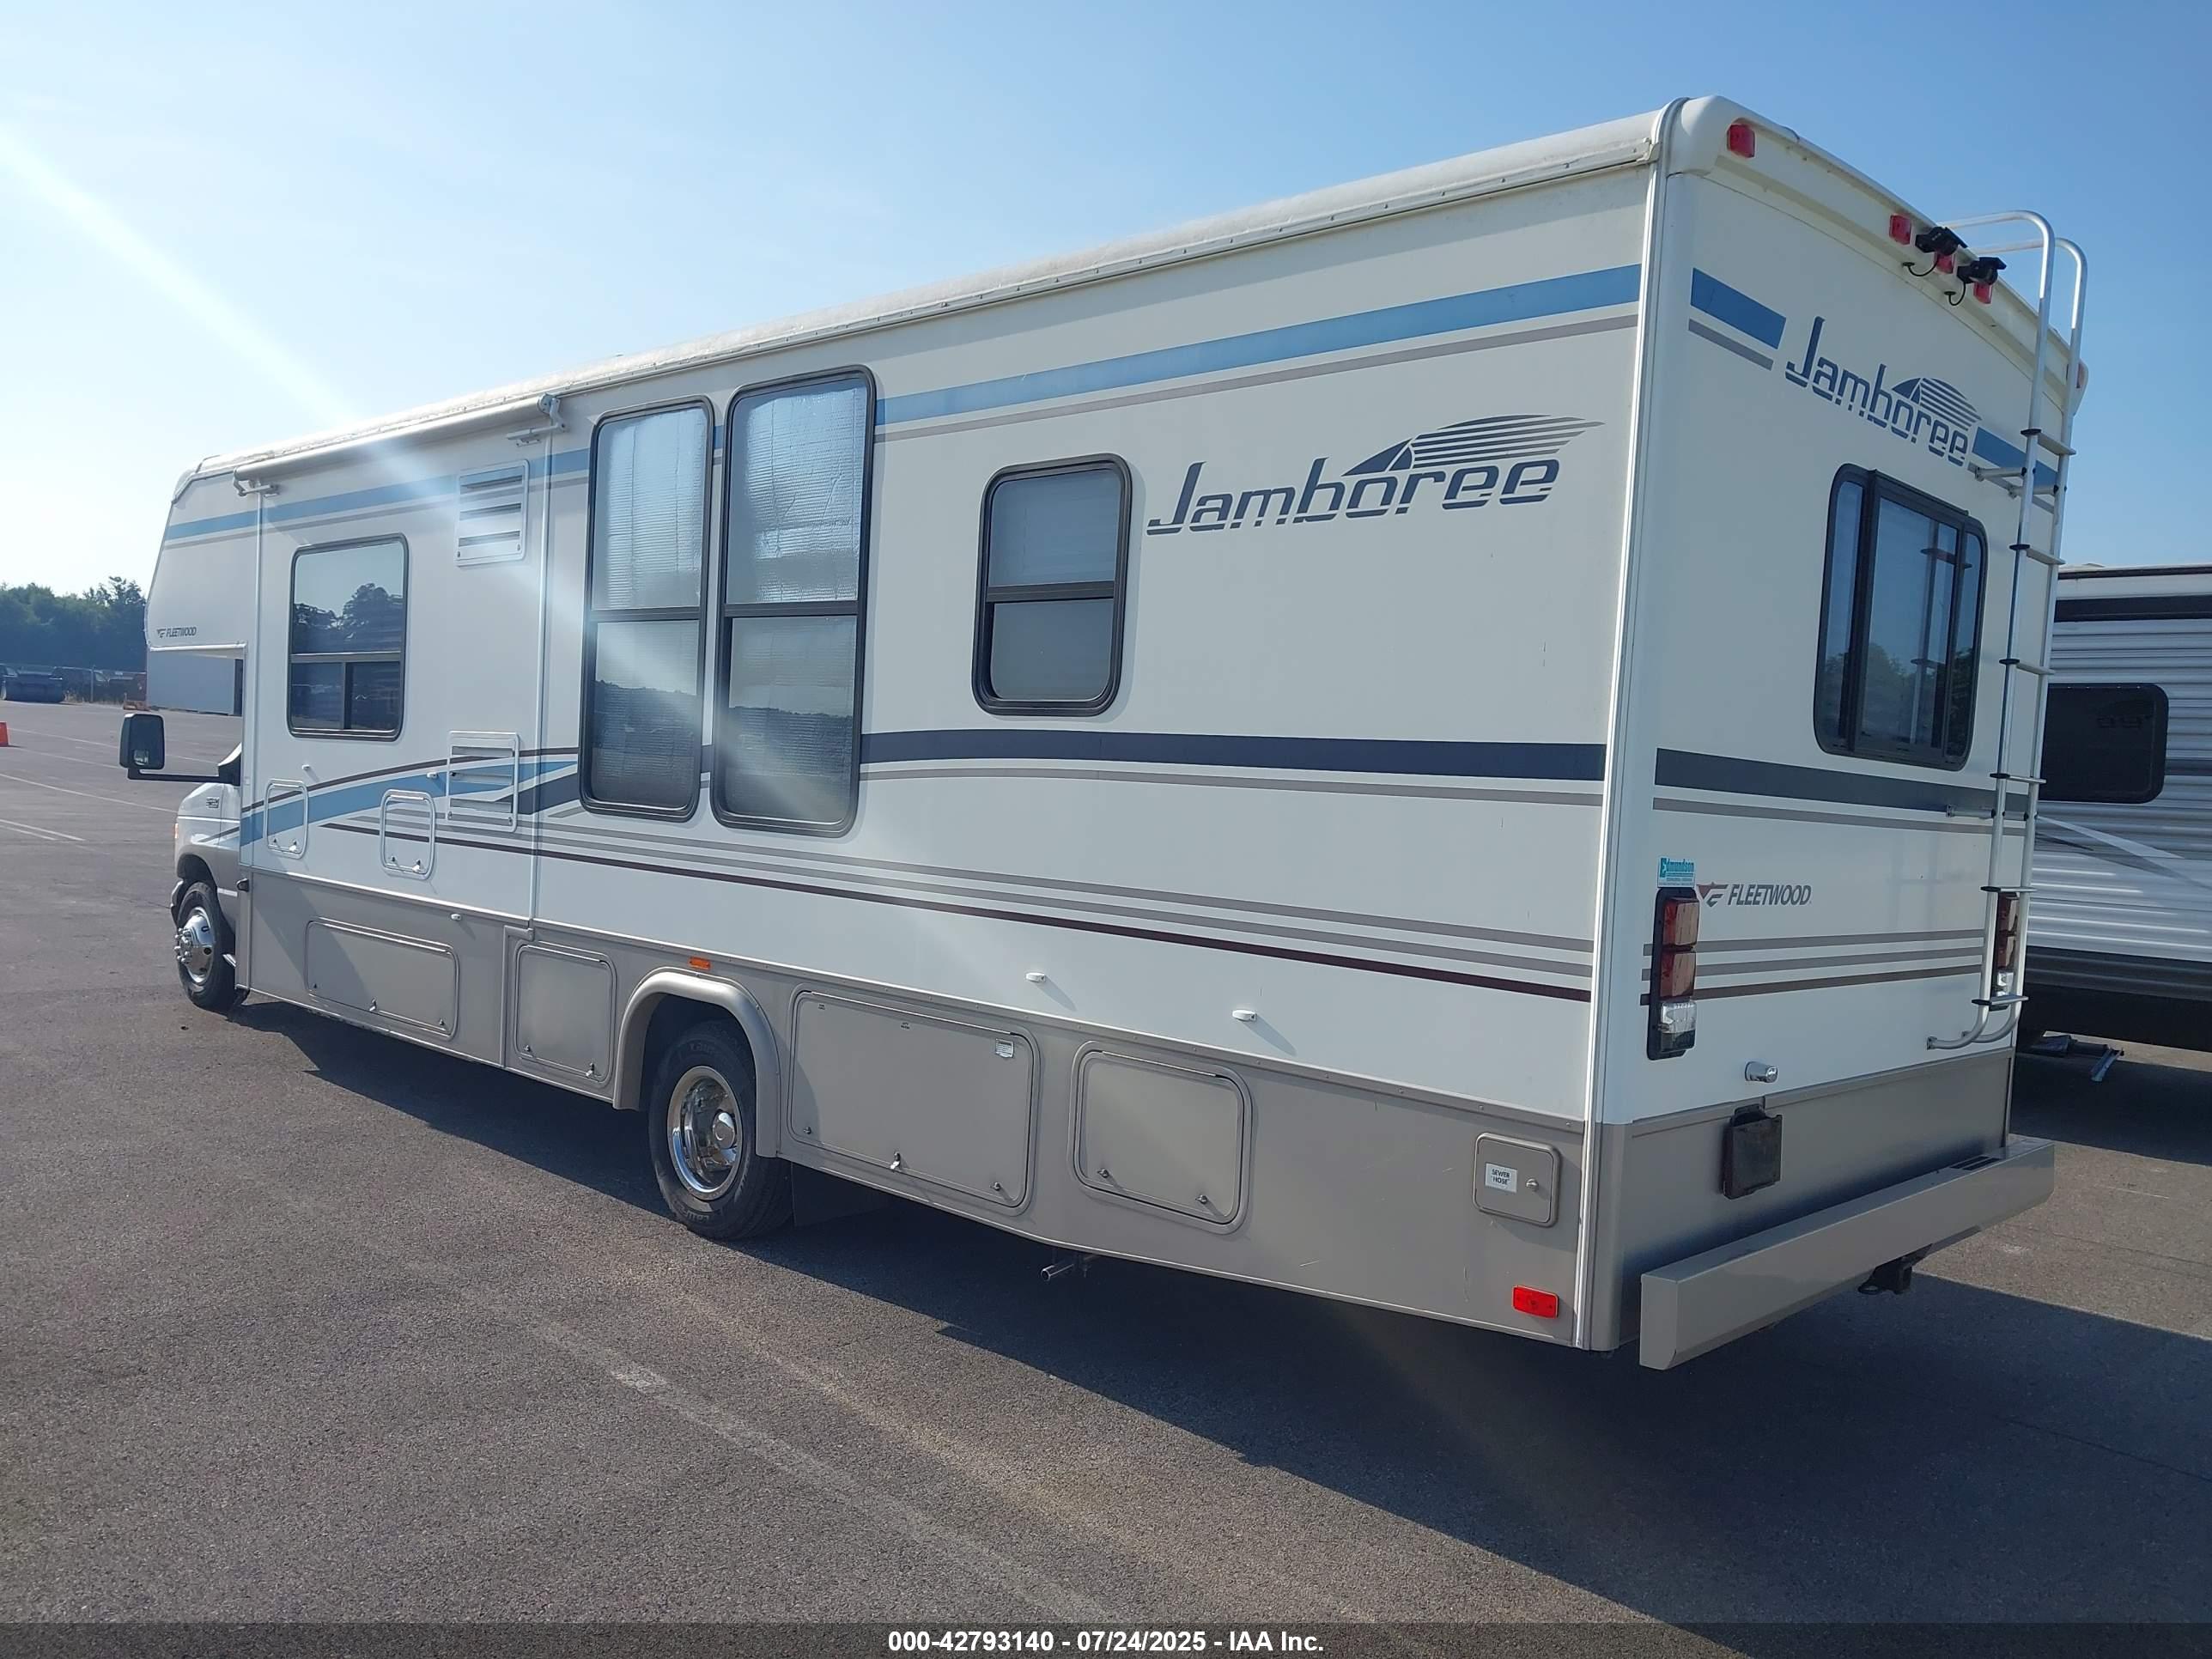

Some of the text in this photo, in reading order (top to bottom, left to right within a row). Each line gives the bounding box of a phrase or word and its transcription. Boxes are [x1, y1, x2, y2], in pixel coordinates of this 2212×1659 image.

[1785, 315, 1969, 466] Jamboree
[1146, 456, 1560, 536] Jamboree
[166, 626, 197, 637] FLEETWOOD
[1728, 884, 1812, 906] FLEETWOOD
[1492, 1169, 1510, 1178] SEWER
[1492, 1176, 1509, 1185] HOSE
